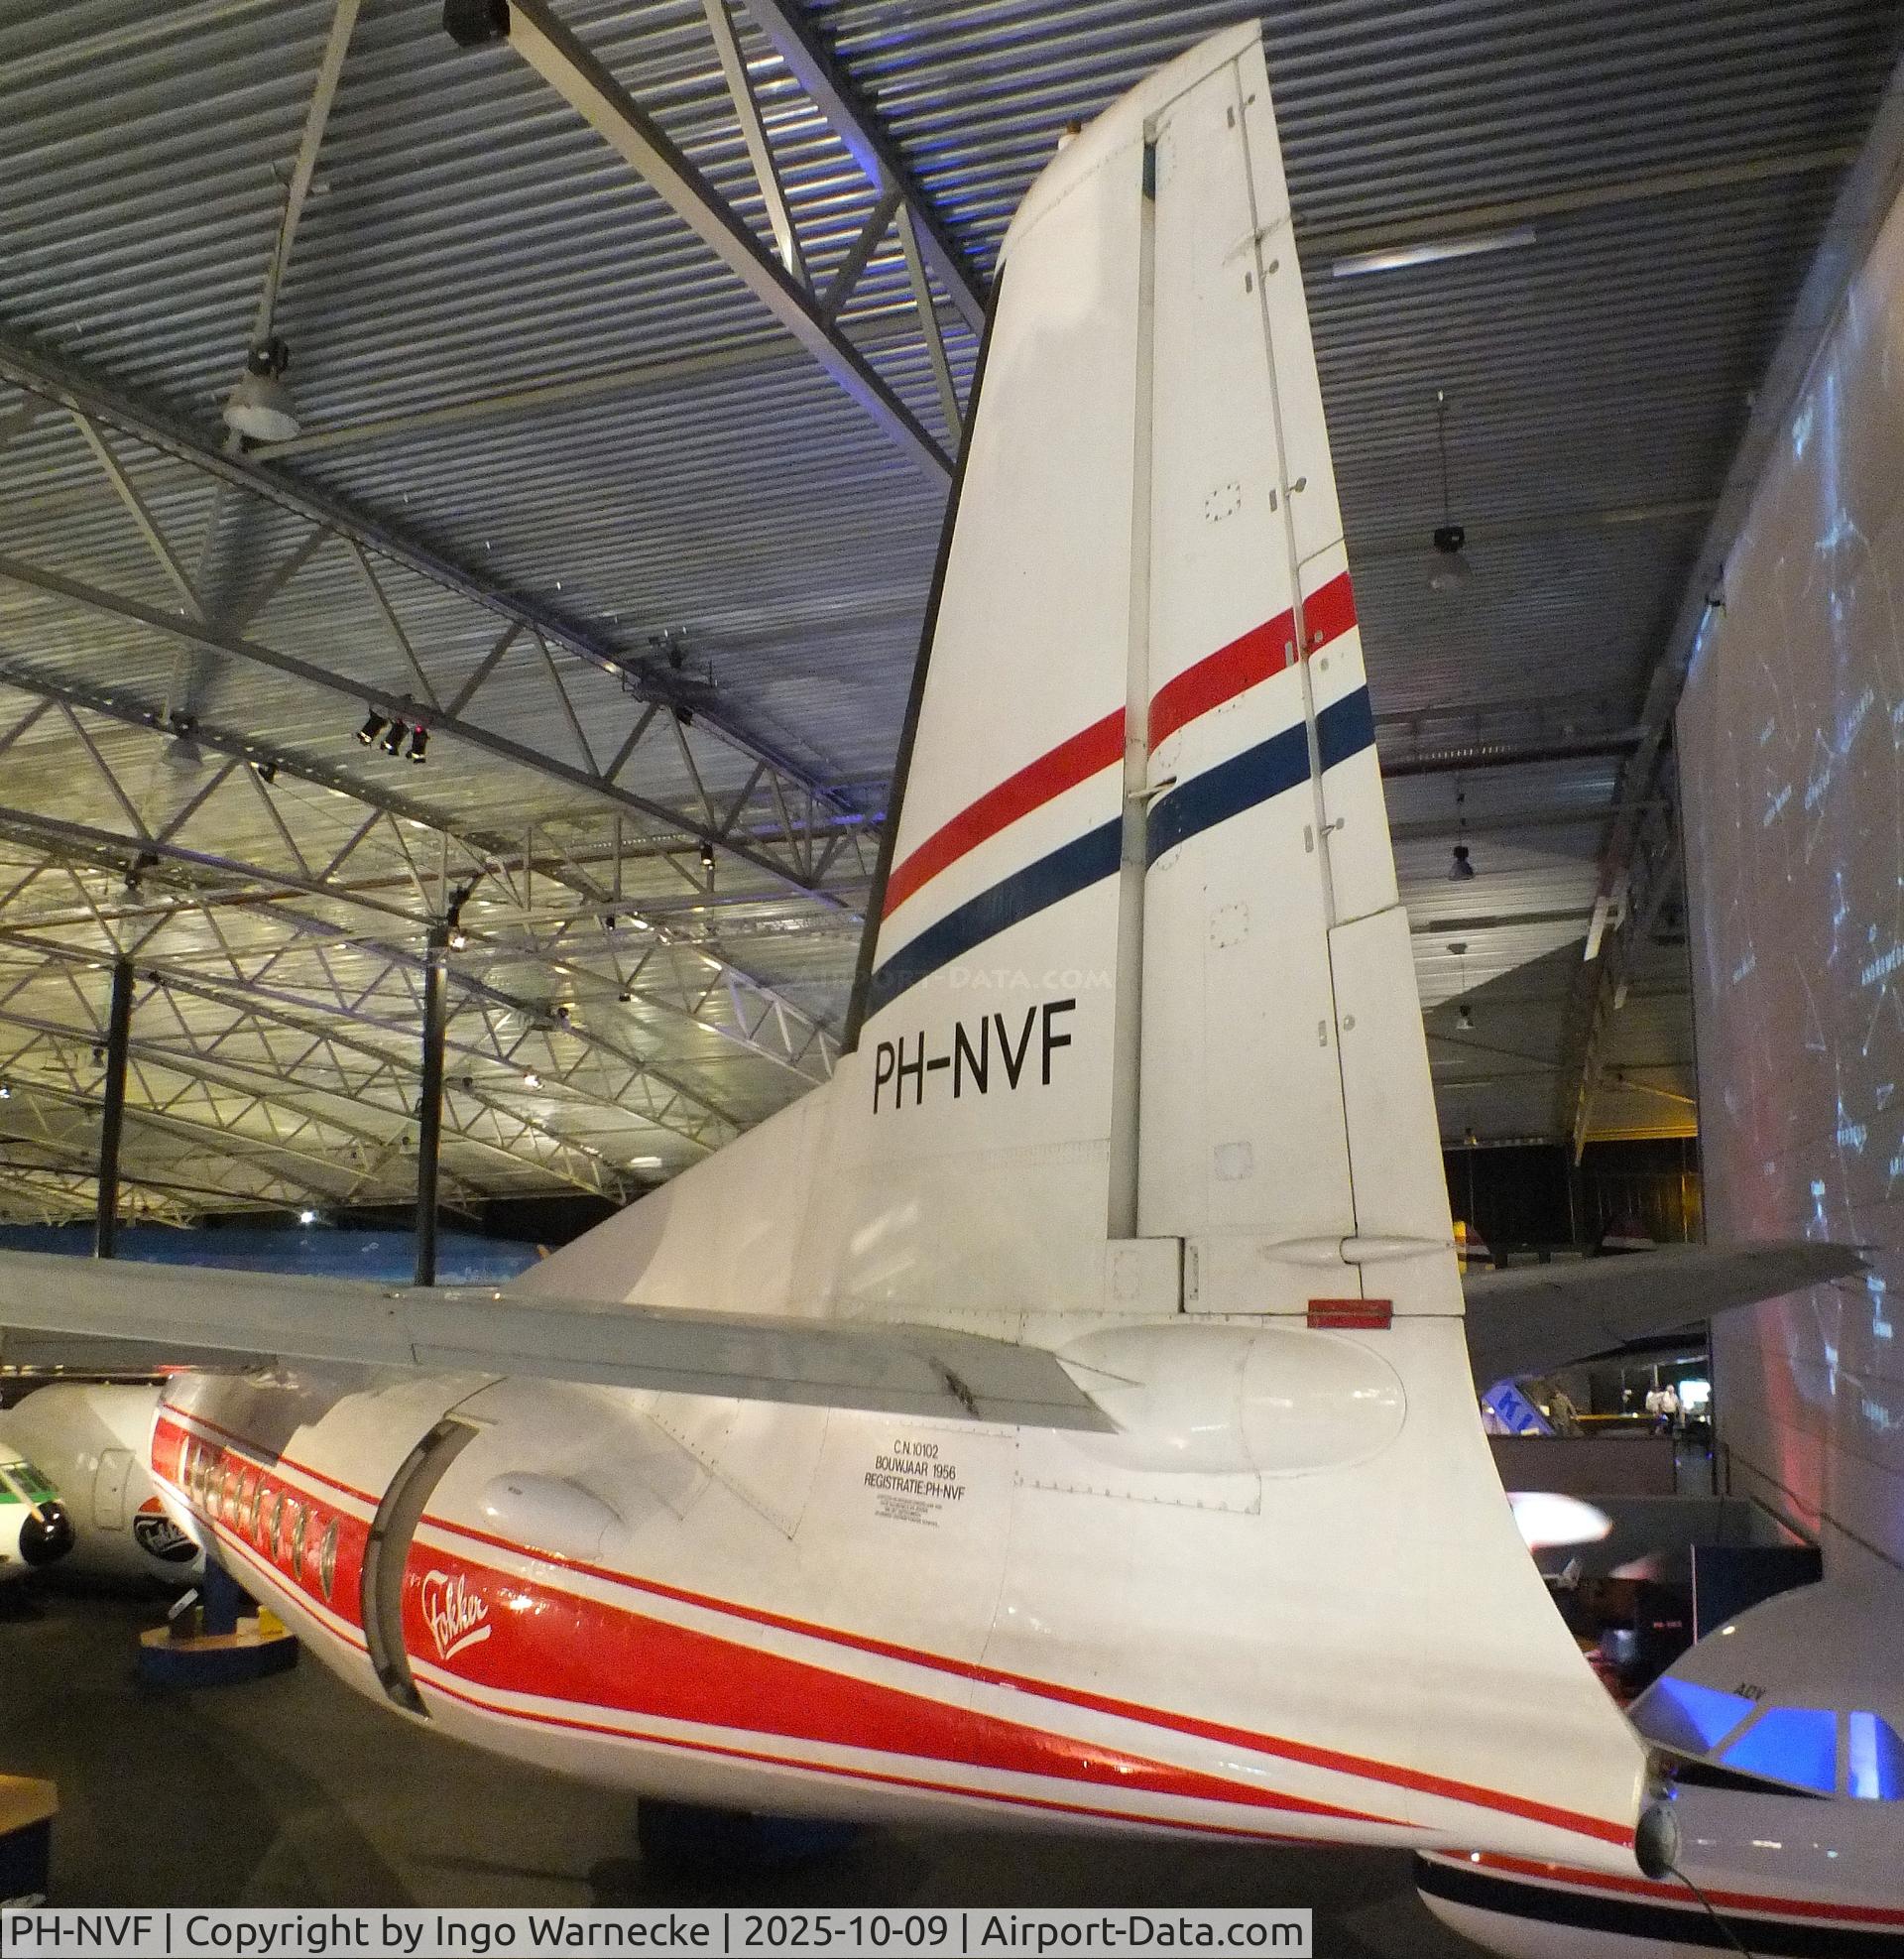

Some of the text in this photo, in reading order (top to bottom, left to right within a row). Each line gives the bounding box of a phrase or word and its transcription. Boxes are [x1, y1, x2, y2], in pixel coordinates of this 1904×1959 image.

[874, 998, 1076, 1114] PH-NVF
[876, 1455, 956, 1480] BOUWJAAR 1956
[421, 1569, 492, 1660] Fokker
